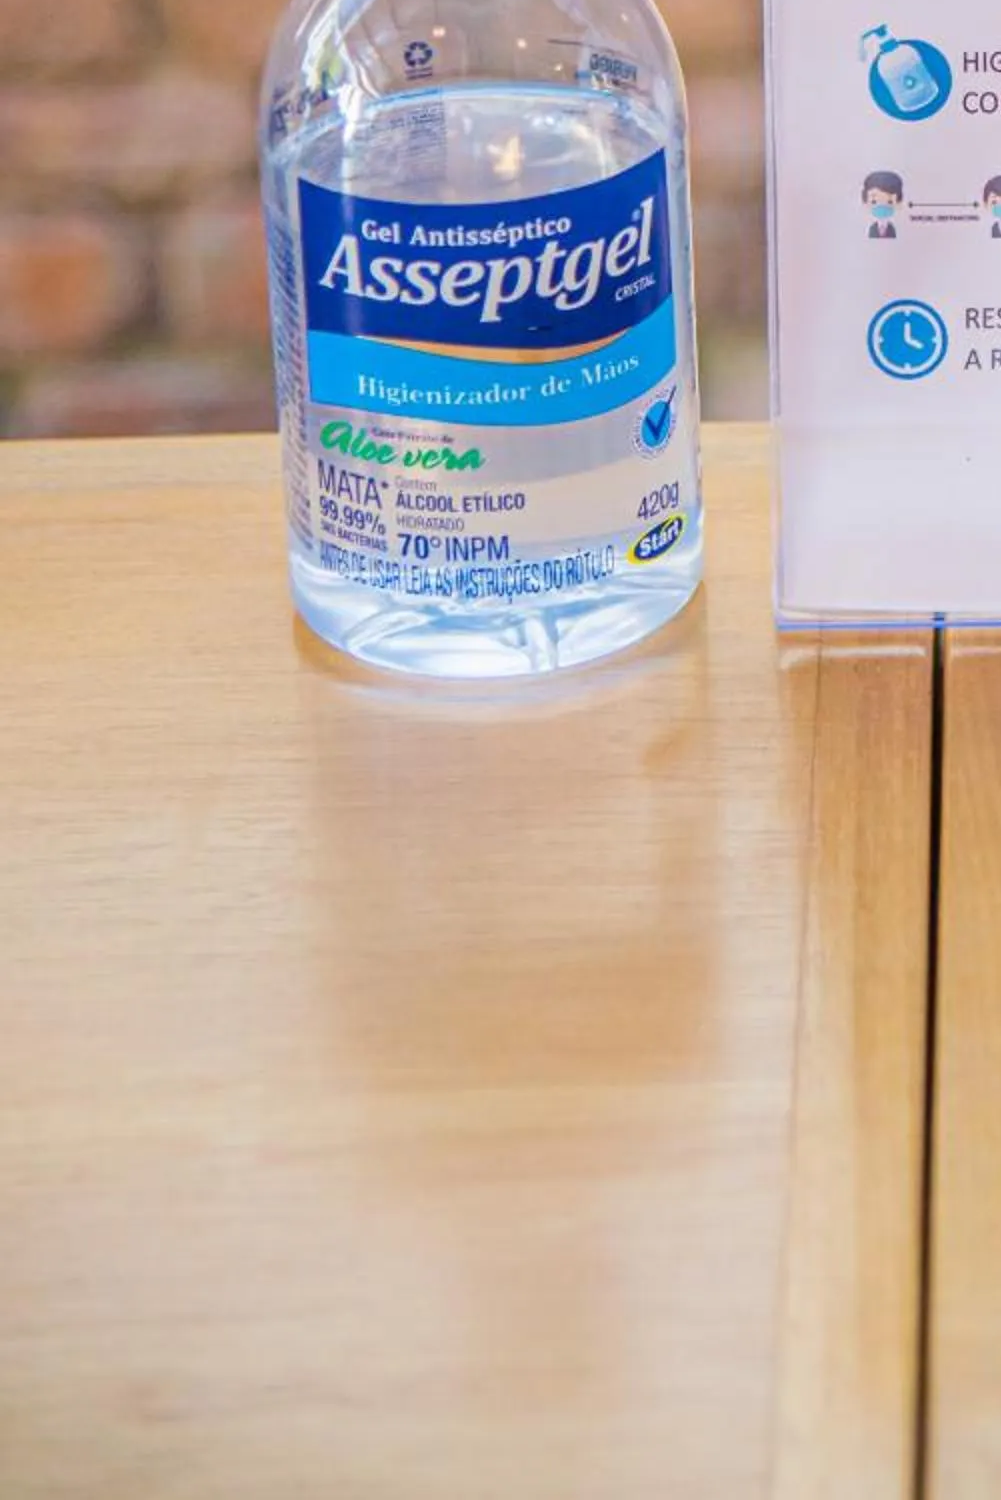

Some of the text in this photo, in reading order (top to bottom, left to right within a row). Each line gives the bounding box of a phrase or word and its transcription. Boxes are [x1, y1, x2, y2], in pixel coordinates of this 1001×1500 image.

[361, 216, 573, 248] Gel Antisséptico
[319, 196, 655, 324] Asseptgel
[963, 347, 983, 371] A
[357, 353, 640, 407] Higienizador de Mãos
[319, 419, 400, 464] Aloe
[402, 446, 487, 472] vera
[395, 489, 526, 513] ÁLCOOL ETÍLICO
[636, 480, 680, 520] 420g
[396, 514, 466, 533] HIDRATADO
[404, 563, 432, 596] LEIA
[435, 564, 452, 597] AS
[455, 559, 541, 604] INSTRUÇÕES
[543, 560, 563, 591] DO
[566, 545, 616, 586] RÓTULO
